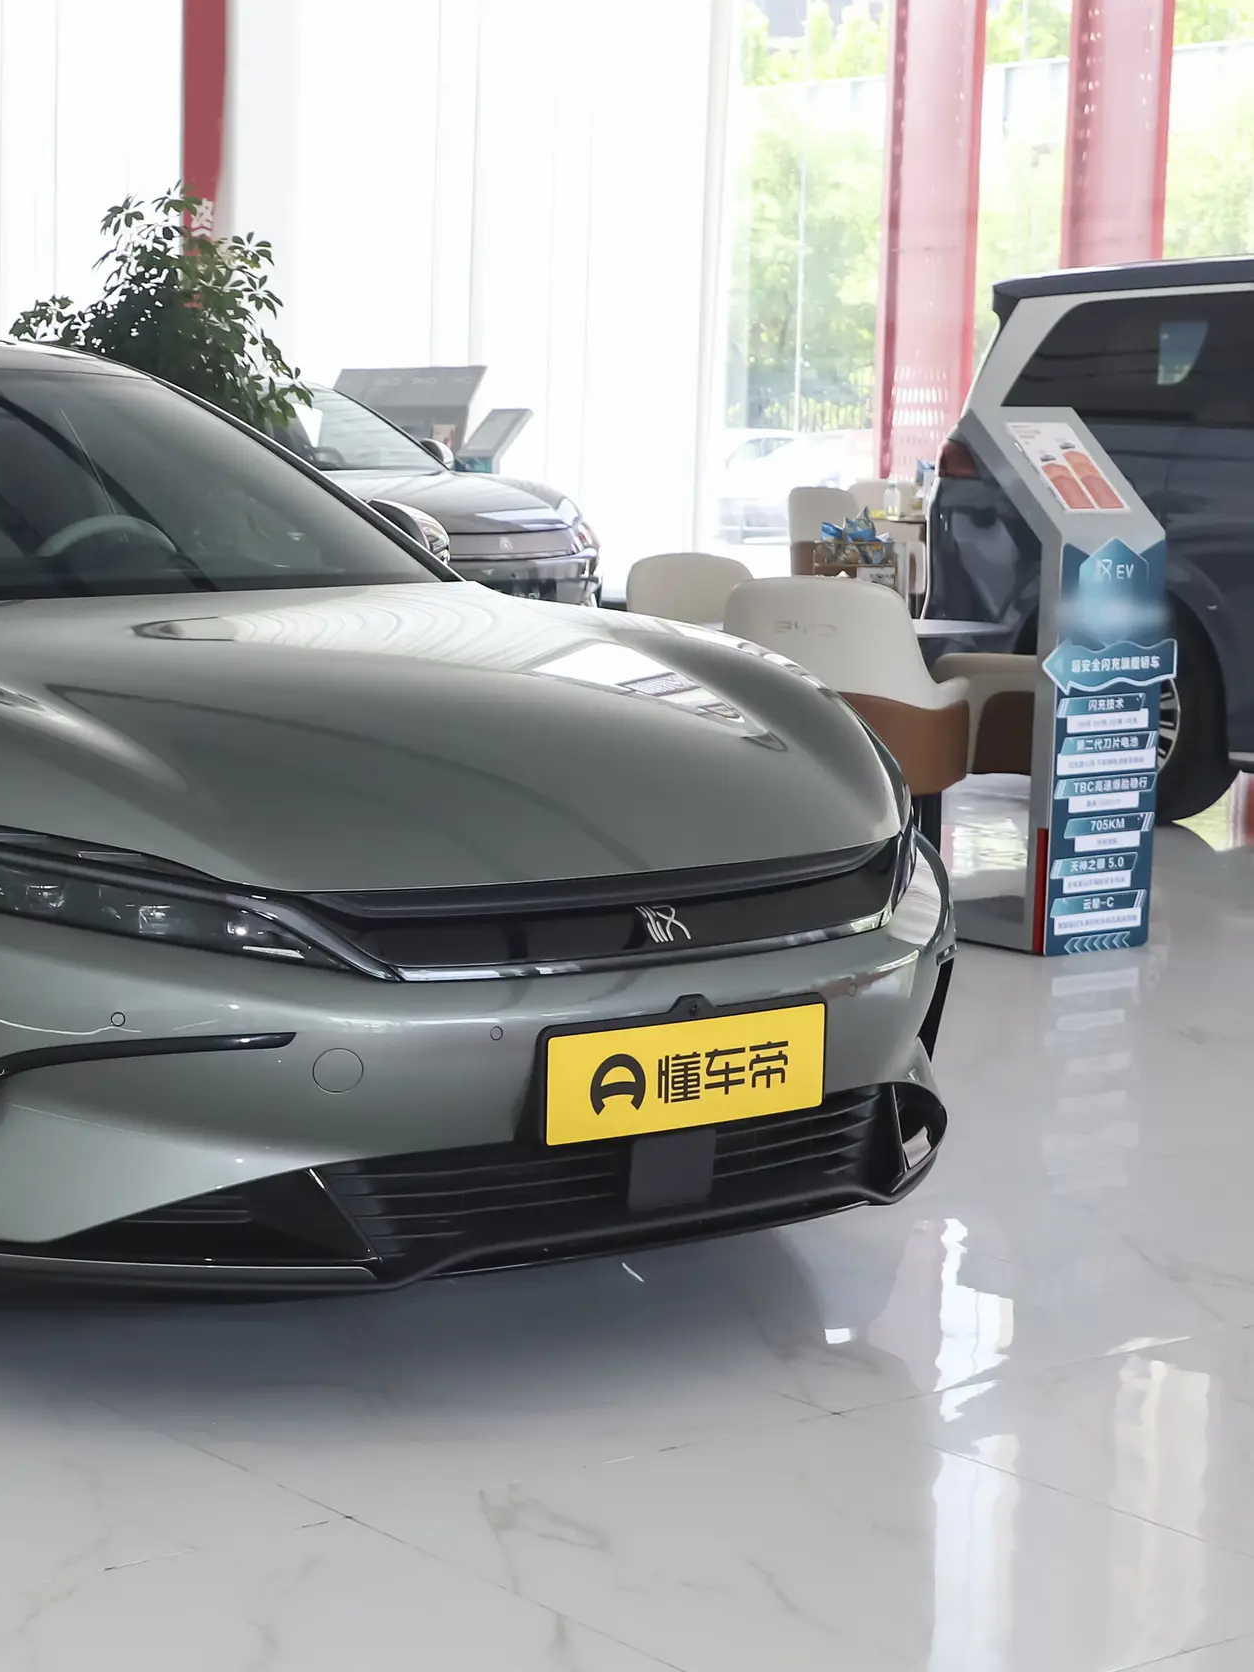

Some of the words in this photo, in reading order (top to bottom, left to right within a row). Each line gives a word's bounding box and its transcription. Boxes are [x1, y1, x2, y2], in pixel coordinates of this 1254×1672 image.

[1117, 564, 1134, 579] EV
[1088, 698, 1125, 712] 闪充技术
[1076, 736, 1139, 751] 第二代刀片电池
[1090, 819, 1125, 831] 705KM
[1108, 856, 1125, 869] 5.0
[657, 1041, 789, 1105] 懂车帝
